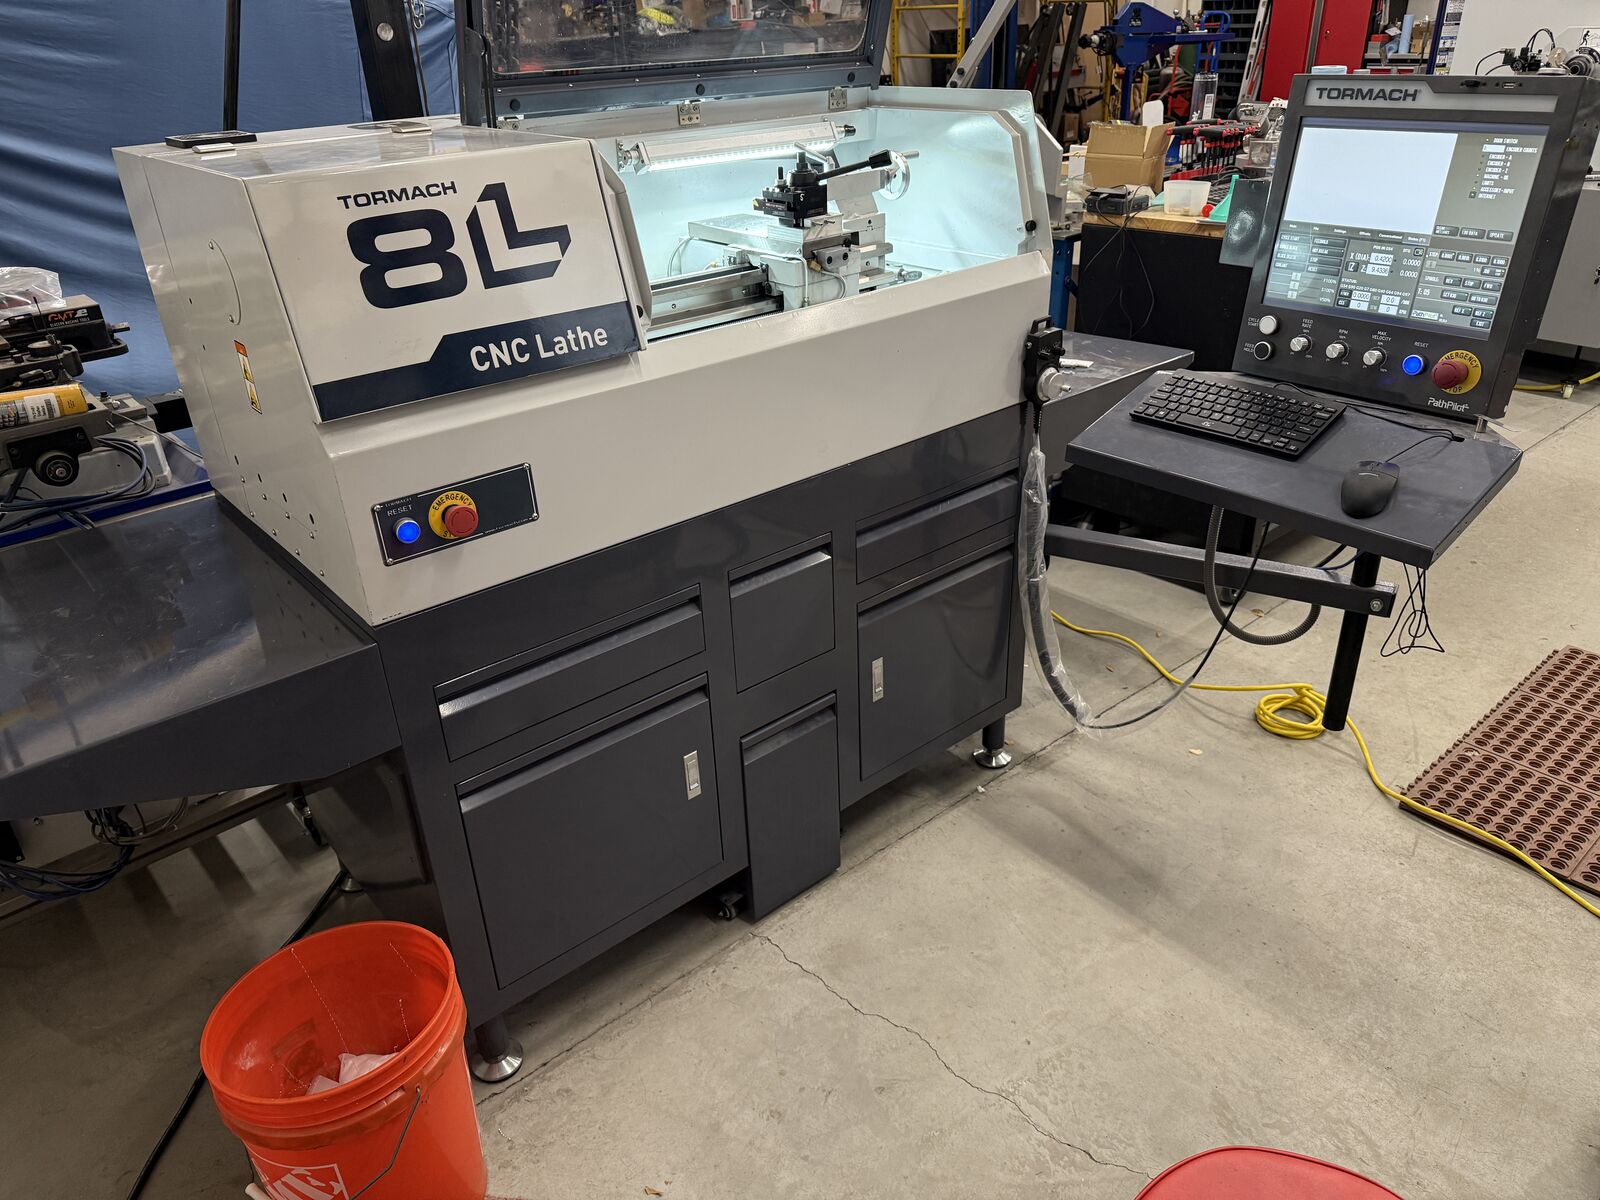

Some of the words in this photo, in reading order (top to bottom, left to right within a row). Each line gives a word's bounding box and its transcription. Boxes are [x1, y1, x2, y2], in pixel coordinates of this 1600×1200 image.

[1316, 87, 1417, 102] TORMACH
[337, 181, 457, 209] TORMACH
[470, 338, 531, 372] CNC
[538, 326, 608, 359] Lathe
[1442, 351, 1479, 368] MERGENCY
[1428, 397, 1464, 412] PathPilot
[432, 493, 472, 511] EMERGENCY
[387, 505, 413, 517] RESET
